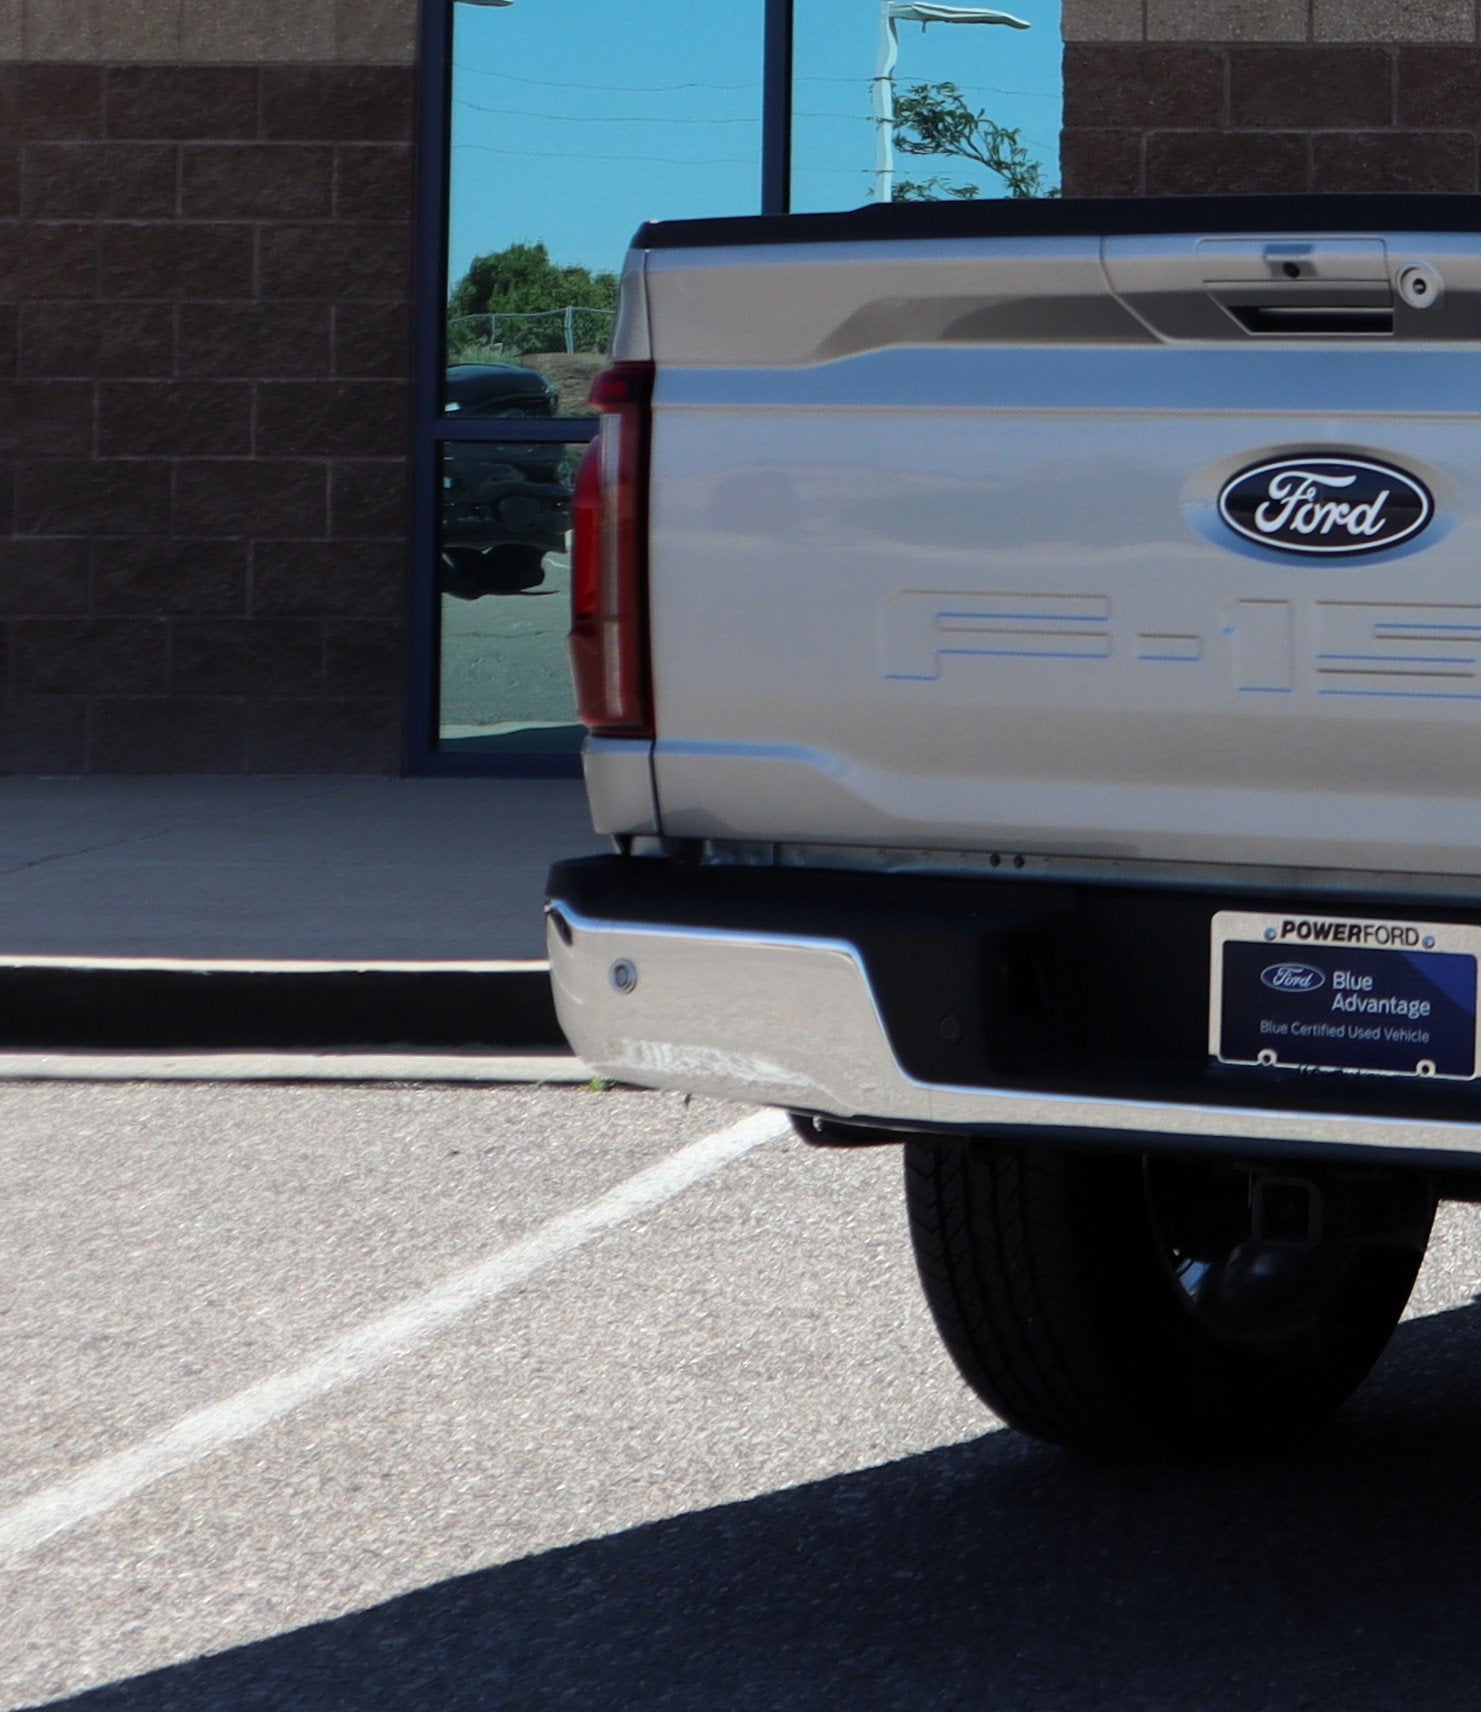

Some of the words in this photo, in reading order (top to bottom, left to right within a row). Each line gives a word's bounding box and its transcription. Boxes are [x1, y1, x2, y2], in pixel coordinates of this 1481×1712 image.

[1253, 470, 1390, 538] Ford
[1280, 919, 1420, 948] POWERFORD
[1271, 967, 1313, 987] Ford
[1332, 970, 1373, 991] Blue
[1331, 993, 1431, 1020] Advantage
[1260, 1020, 1288, 1035] Blue
[1291, 1021, 1345, 1038] Certified
[1348, 1024, 1381, 1041] Used
[1384, 1027, 1430, 1044] Vehicle
